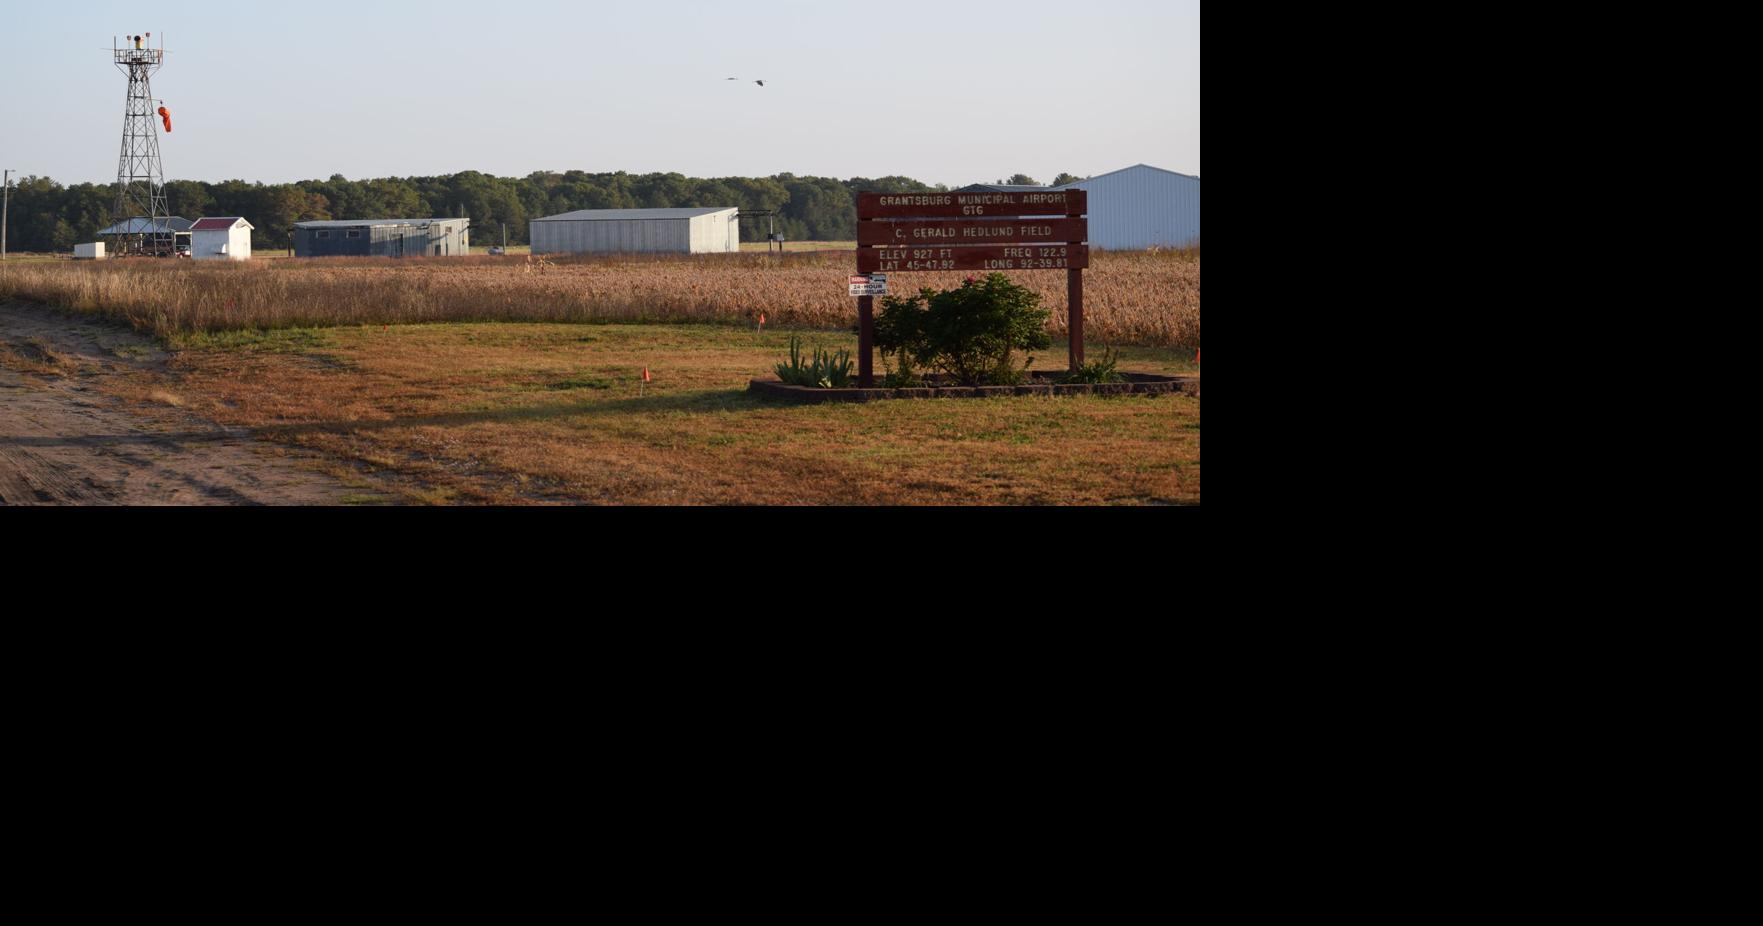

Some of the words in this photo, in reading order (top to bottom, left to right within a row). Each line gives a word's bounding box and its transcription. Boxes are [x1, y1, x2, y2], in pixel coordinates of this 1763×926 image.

[880, 196, 951, 206] GRANTSBURG
[958, 194, 1016, 205] MUNICIPAL
[1022, 194, 1066, 204] AIRPORT
[963, 205, 984, 215] GTG
[896, 228, 906, 238] C.
[913, 227, 956, 238] GERALD
[963, 226, 1013, 237] HEDLUND
[1021, 226, 1052, 236] FIELD
[880, 250, 907, 260] ELEV
[914, 249, 932, 259] 927
[940, 248, 952, 258] FT
[1004, 247, 1032, 258] FREQ
[1040, 247, 1067, 257] 122.9
[880, 260, 899, 271] LAT
[984, 259, 1013, 270] LONG
